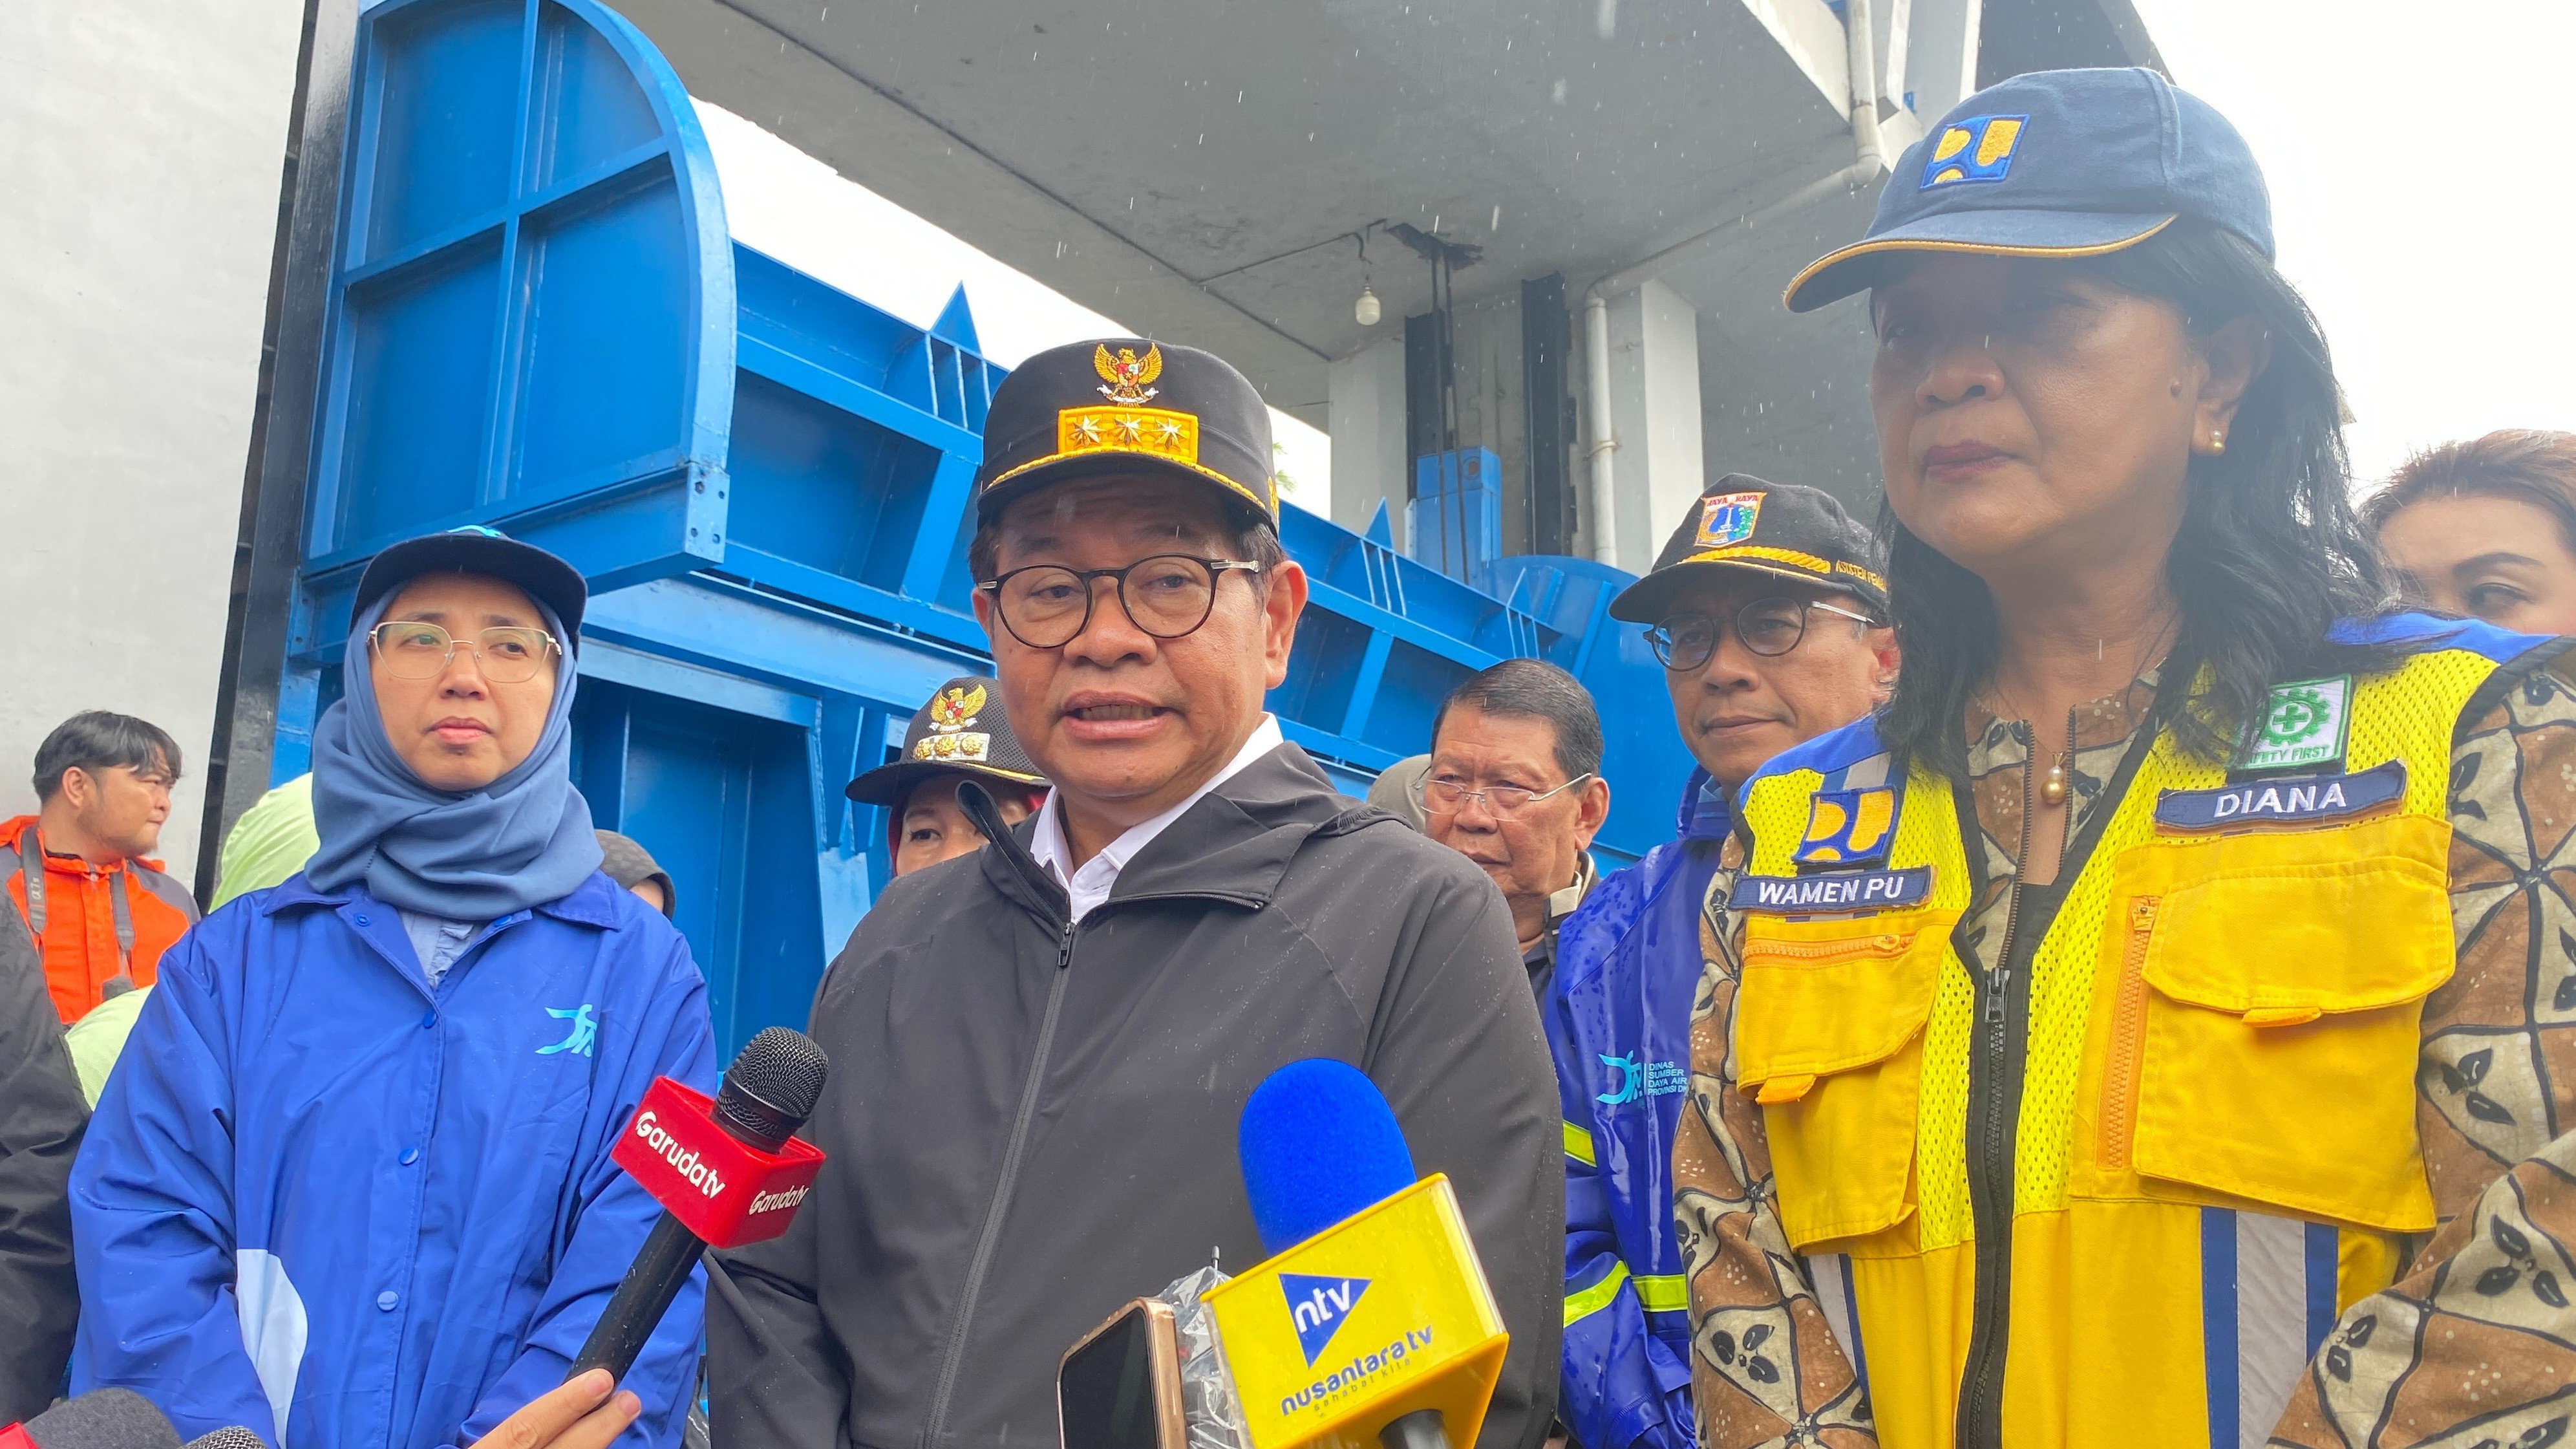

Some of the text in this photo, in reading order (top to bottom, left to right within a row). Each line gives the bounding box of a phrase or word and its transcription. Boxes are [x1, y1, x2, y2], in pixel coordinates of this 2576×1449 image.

[2291, 746, 2330, 760] FIRST
[2214, 783, 2347, 817] DIANA
[1758, 876, 1904, 905] WAMEN PU
[1648, 1069, 1684, 1079] SUMBER
[1649, 1061, 1674, 1071] DINAS
[1648, 1078, 1668, 1088] DAYA
[1648, 1086, 1676, 1095] PROVINSI
[635, 1111, 726, 1199] Garudatv
[749, 1185, 809, 1215] Garudatv
[1295, 1280, 1350, 1333] ntv
[1314, 1358, 1410, 1411] sahabat kita
